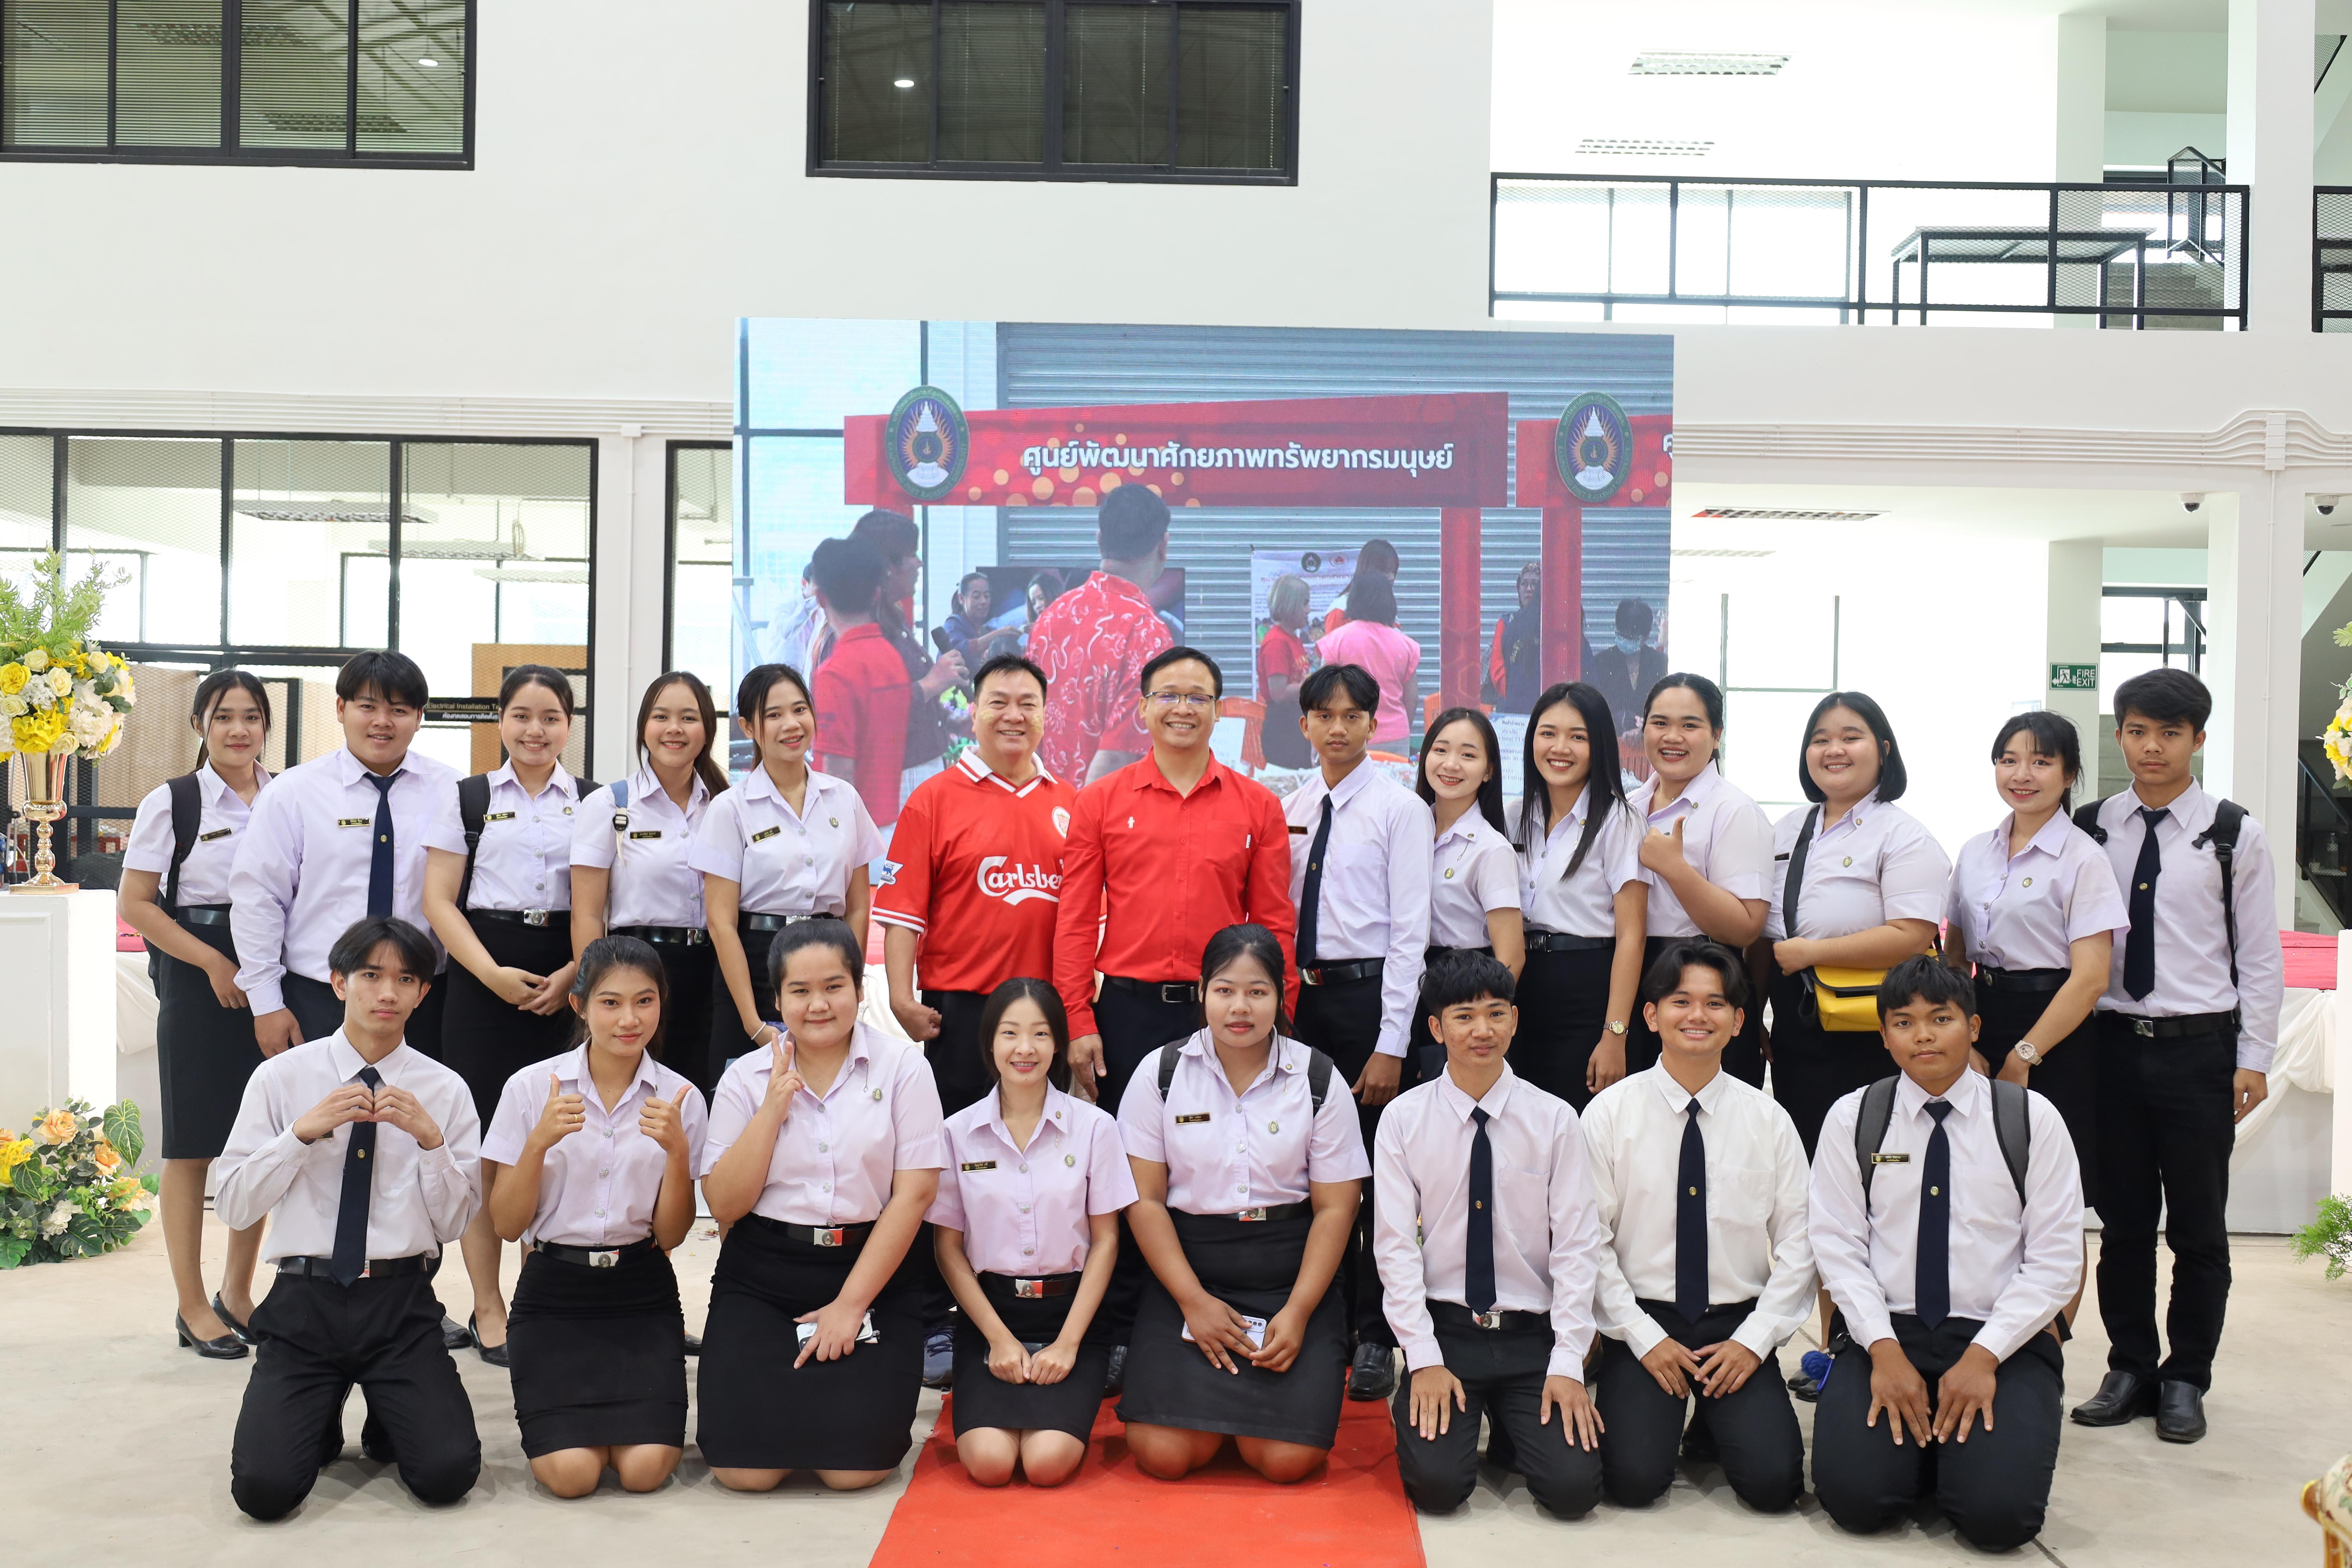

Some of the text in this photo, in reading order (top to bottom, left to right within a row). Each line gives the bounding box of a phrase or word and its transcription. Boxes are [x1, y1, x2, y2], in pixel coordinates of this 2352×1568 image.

[1023, 440, 1454, 477] ศูนย์พัฒนาศักยภาพทรัพยากรมนุษย์
[2076, 678, 2095, 687] EXIT
[2077, 669, 2095, 678] FIRE
[977, 856, 1063, 896] Carlsbe
